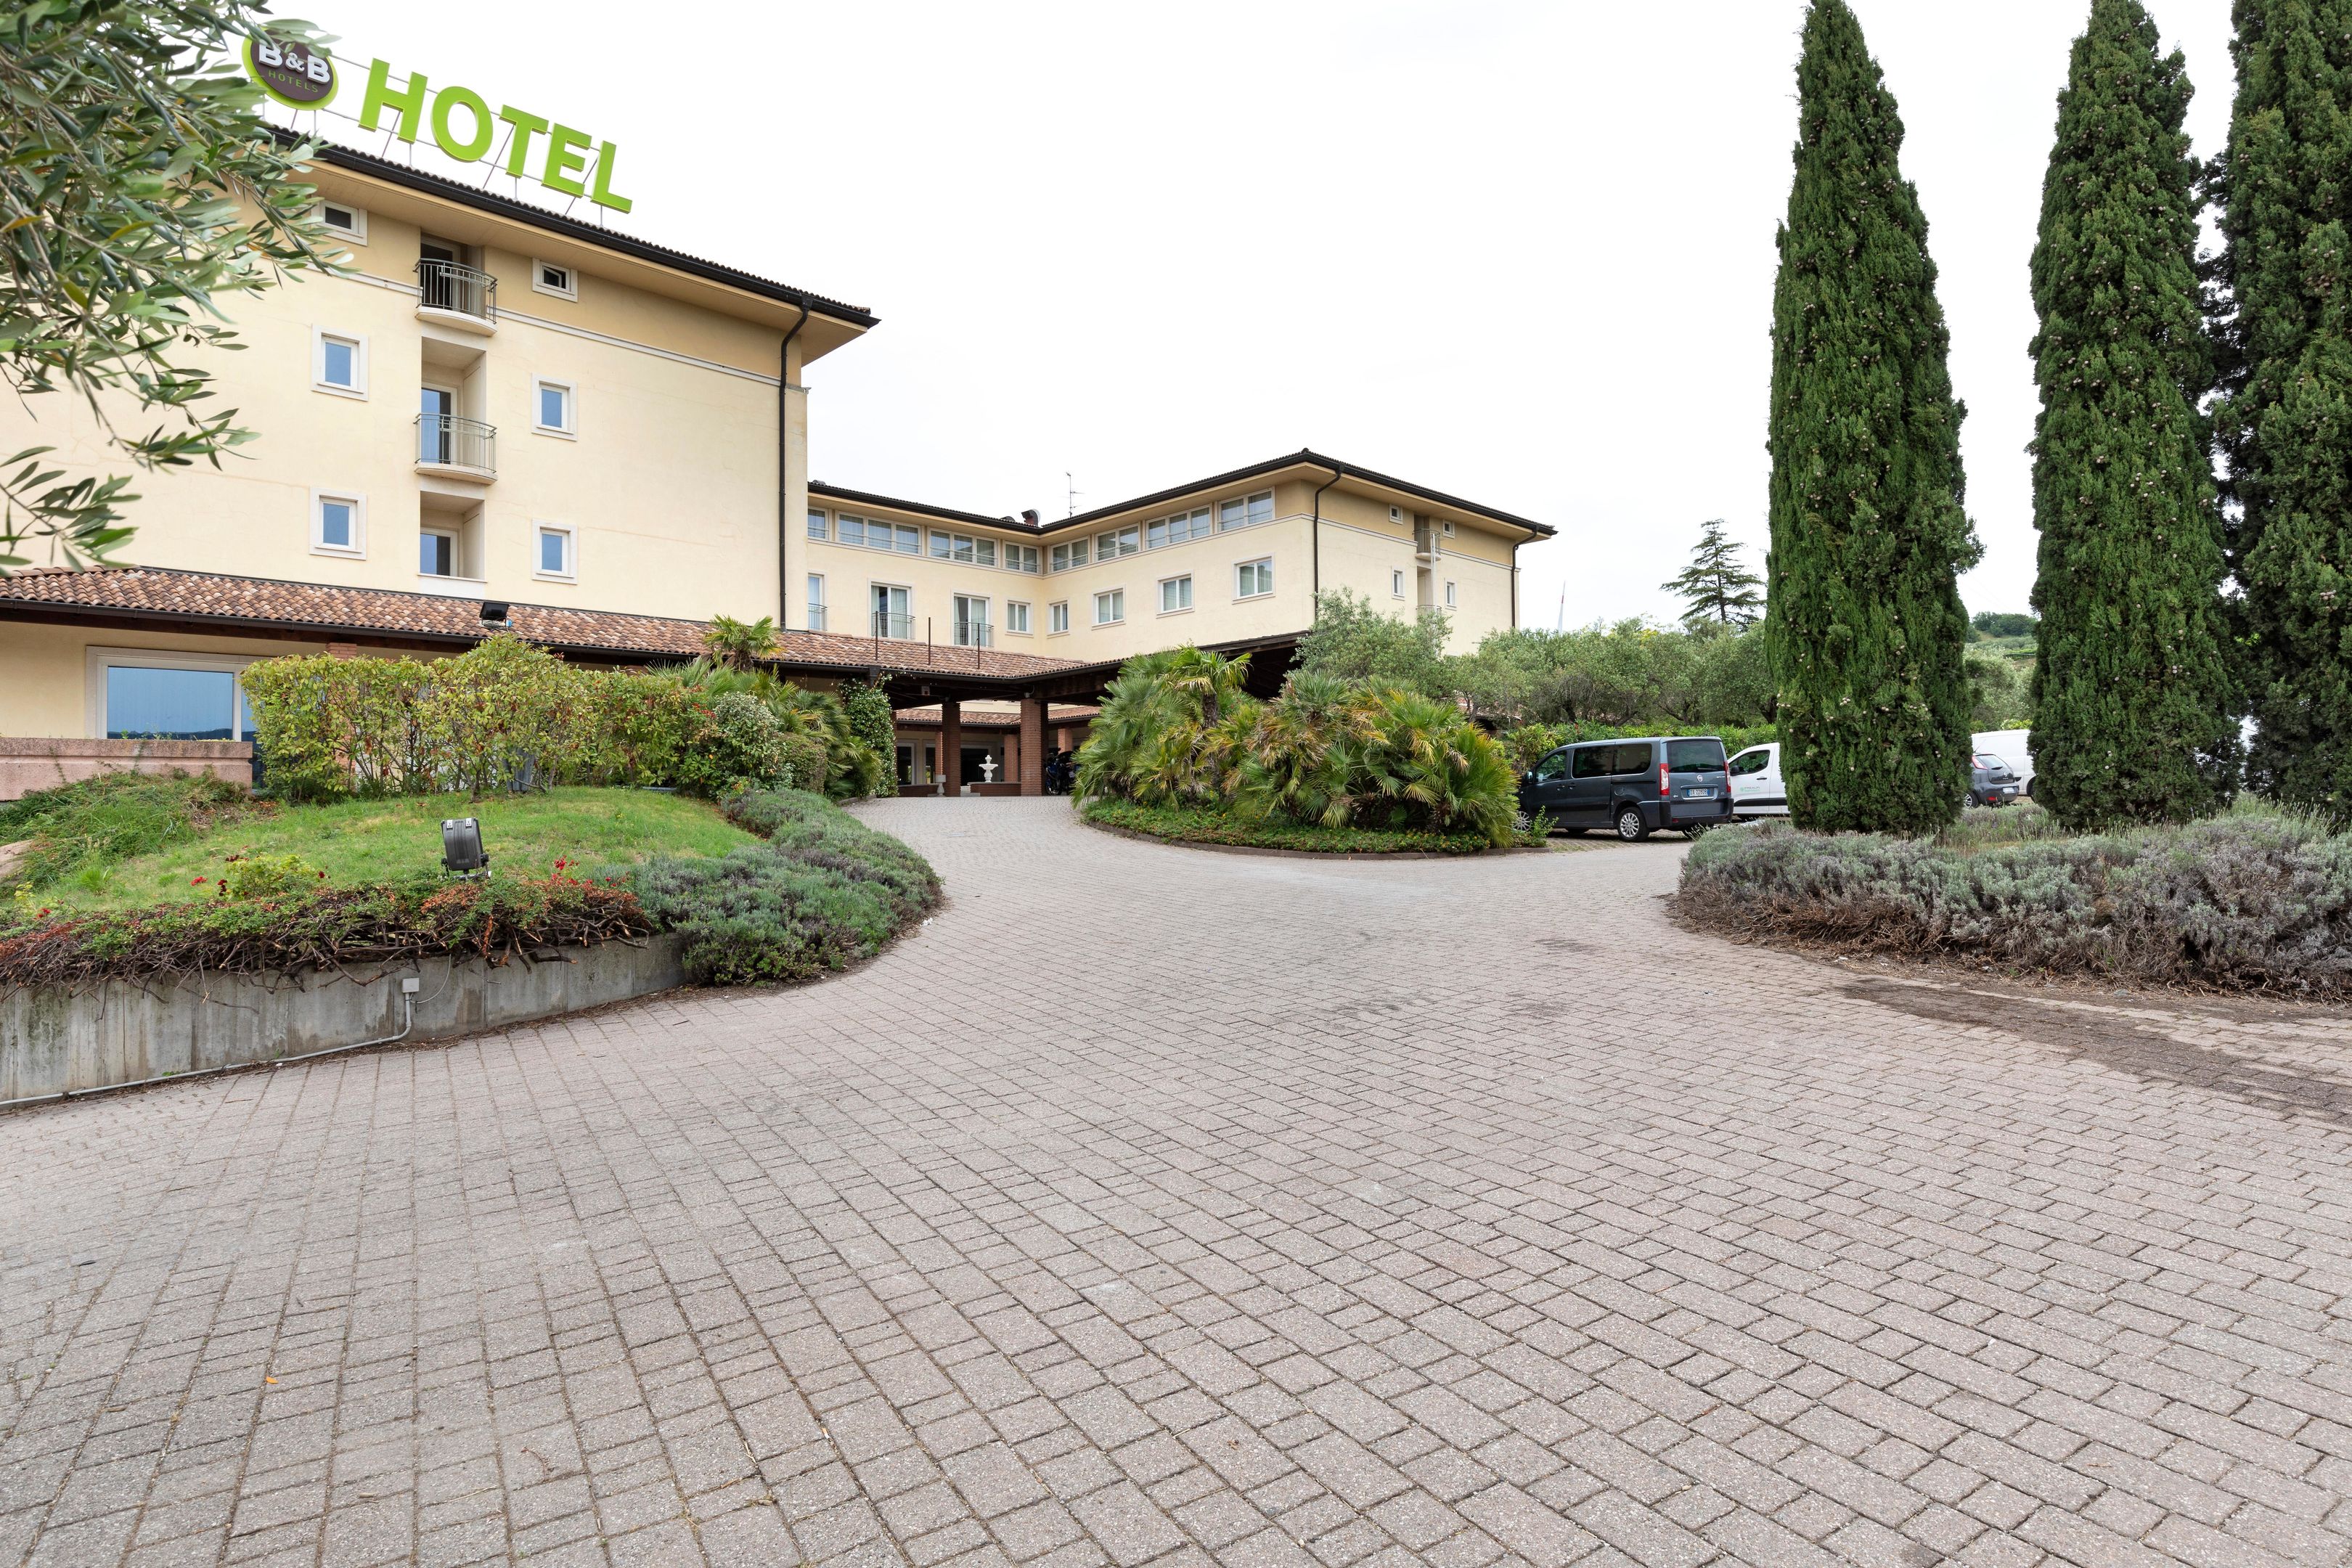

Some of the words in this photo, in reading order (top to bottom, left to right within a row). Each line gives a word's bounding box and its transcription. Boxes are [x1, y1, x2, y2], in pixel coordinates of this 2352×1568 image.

[258, 41, 330, 84] B&B
[268, 70, 319, 93] HOTELS
[359, 57, 632, 214] HOTEL
